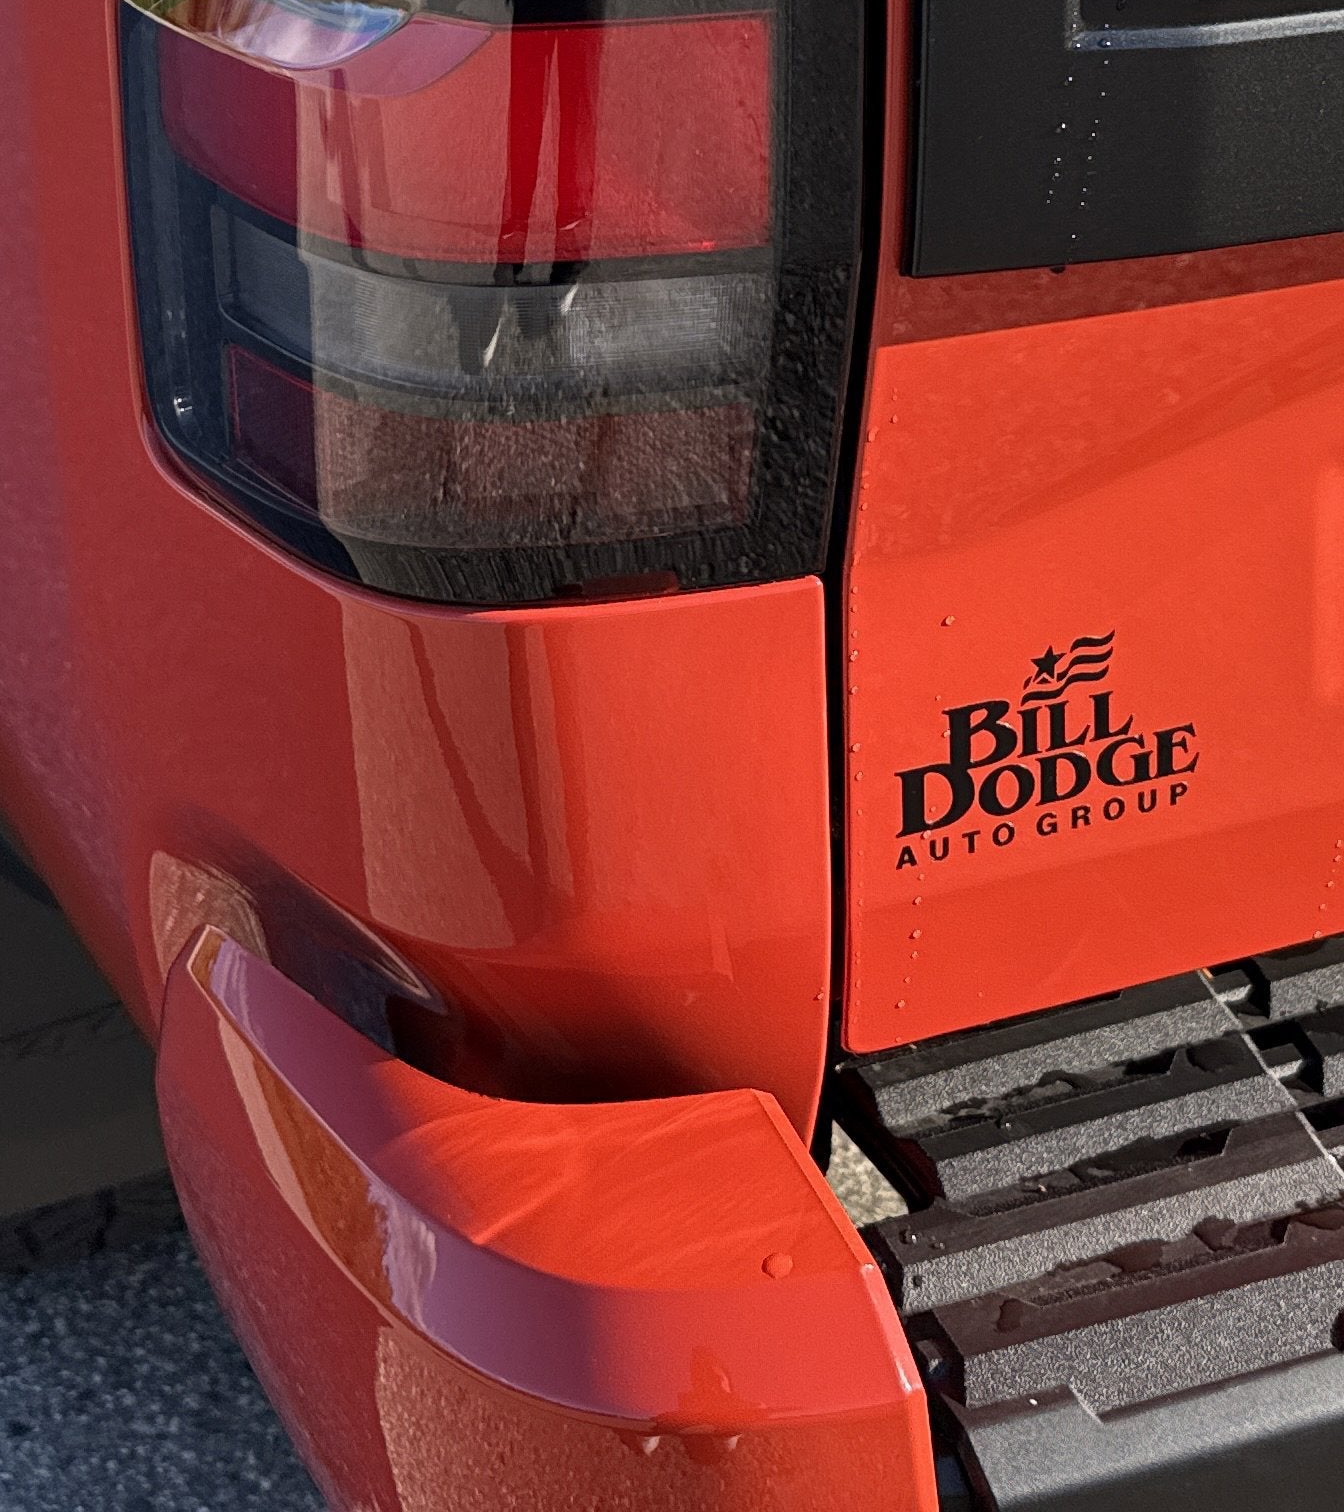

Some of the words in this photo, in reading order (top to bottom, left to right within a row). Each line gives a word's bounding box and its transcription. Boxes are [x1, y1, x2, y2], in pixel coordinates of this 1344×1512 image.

[942, 690, 1134, 770] BILL
[894, 722, 1200, 838] DODGE
[895, 822, 1016, 870] AUTO
[1035, 781, 1189, 838] GROUP
